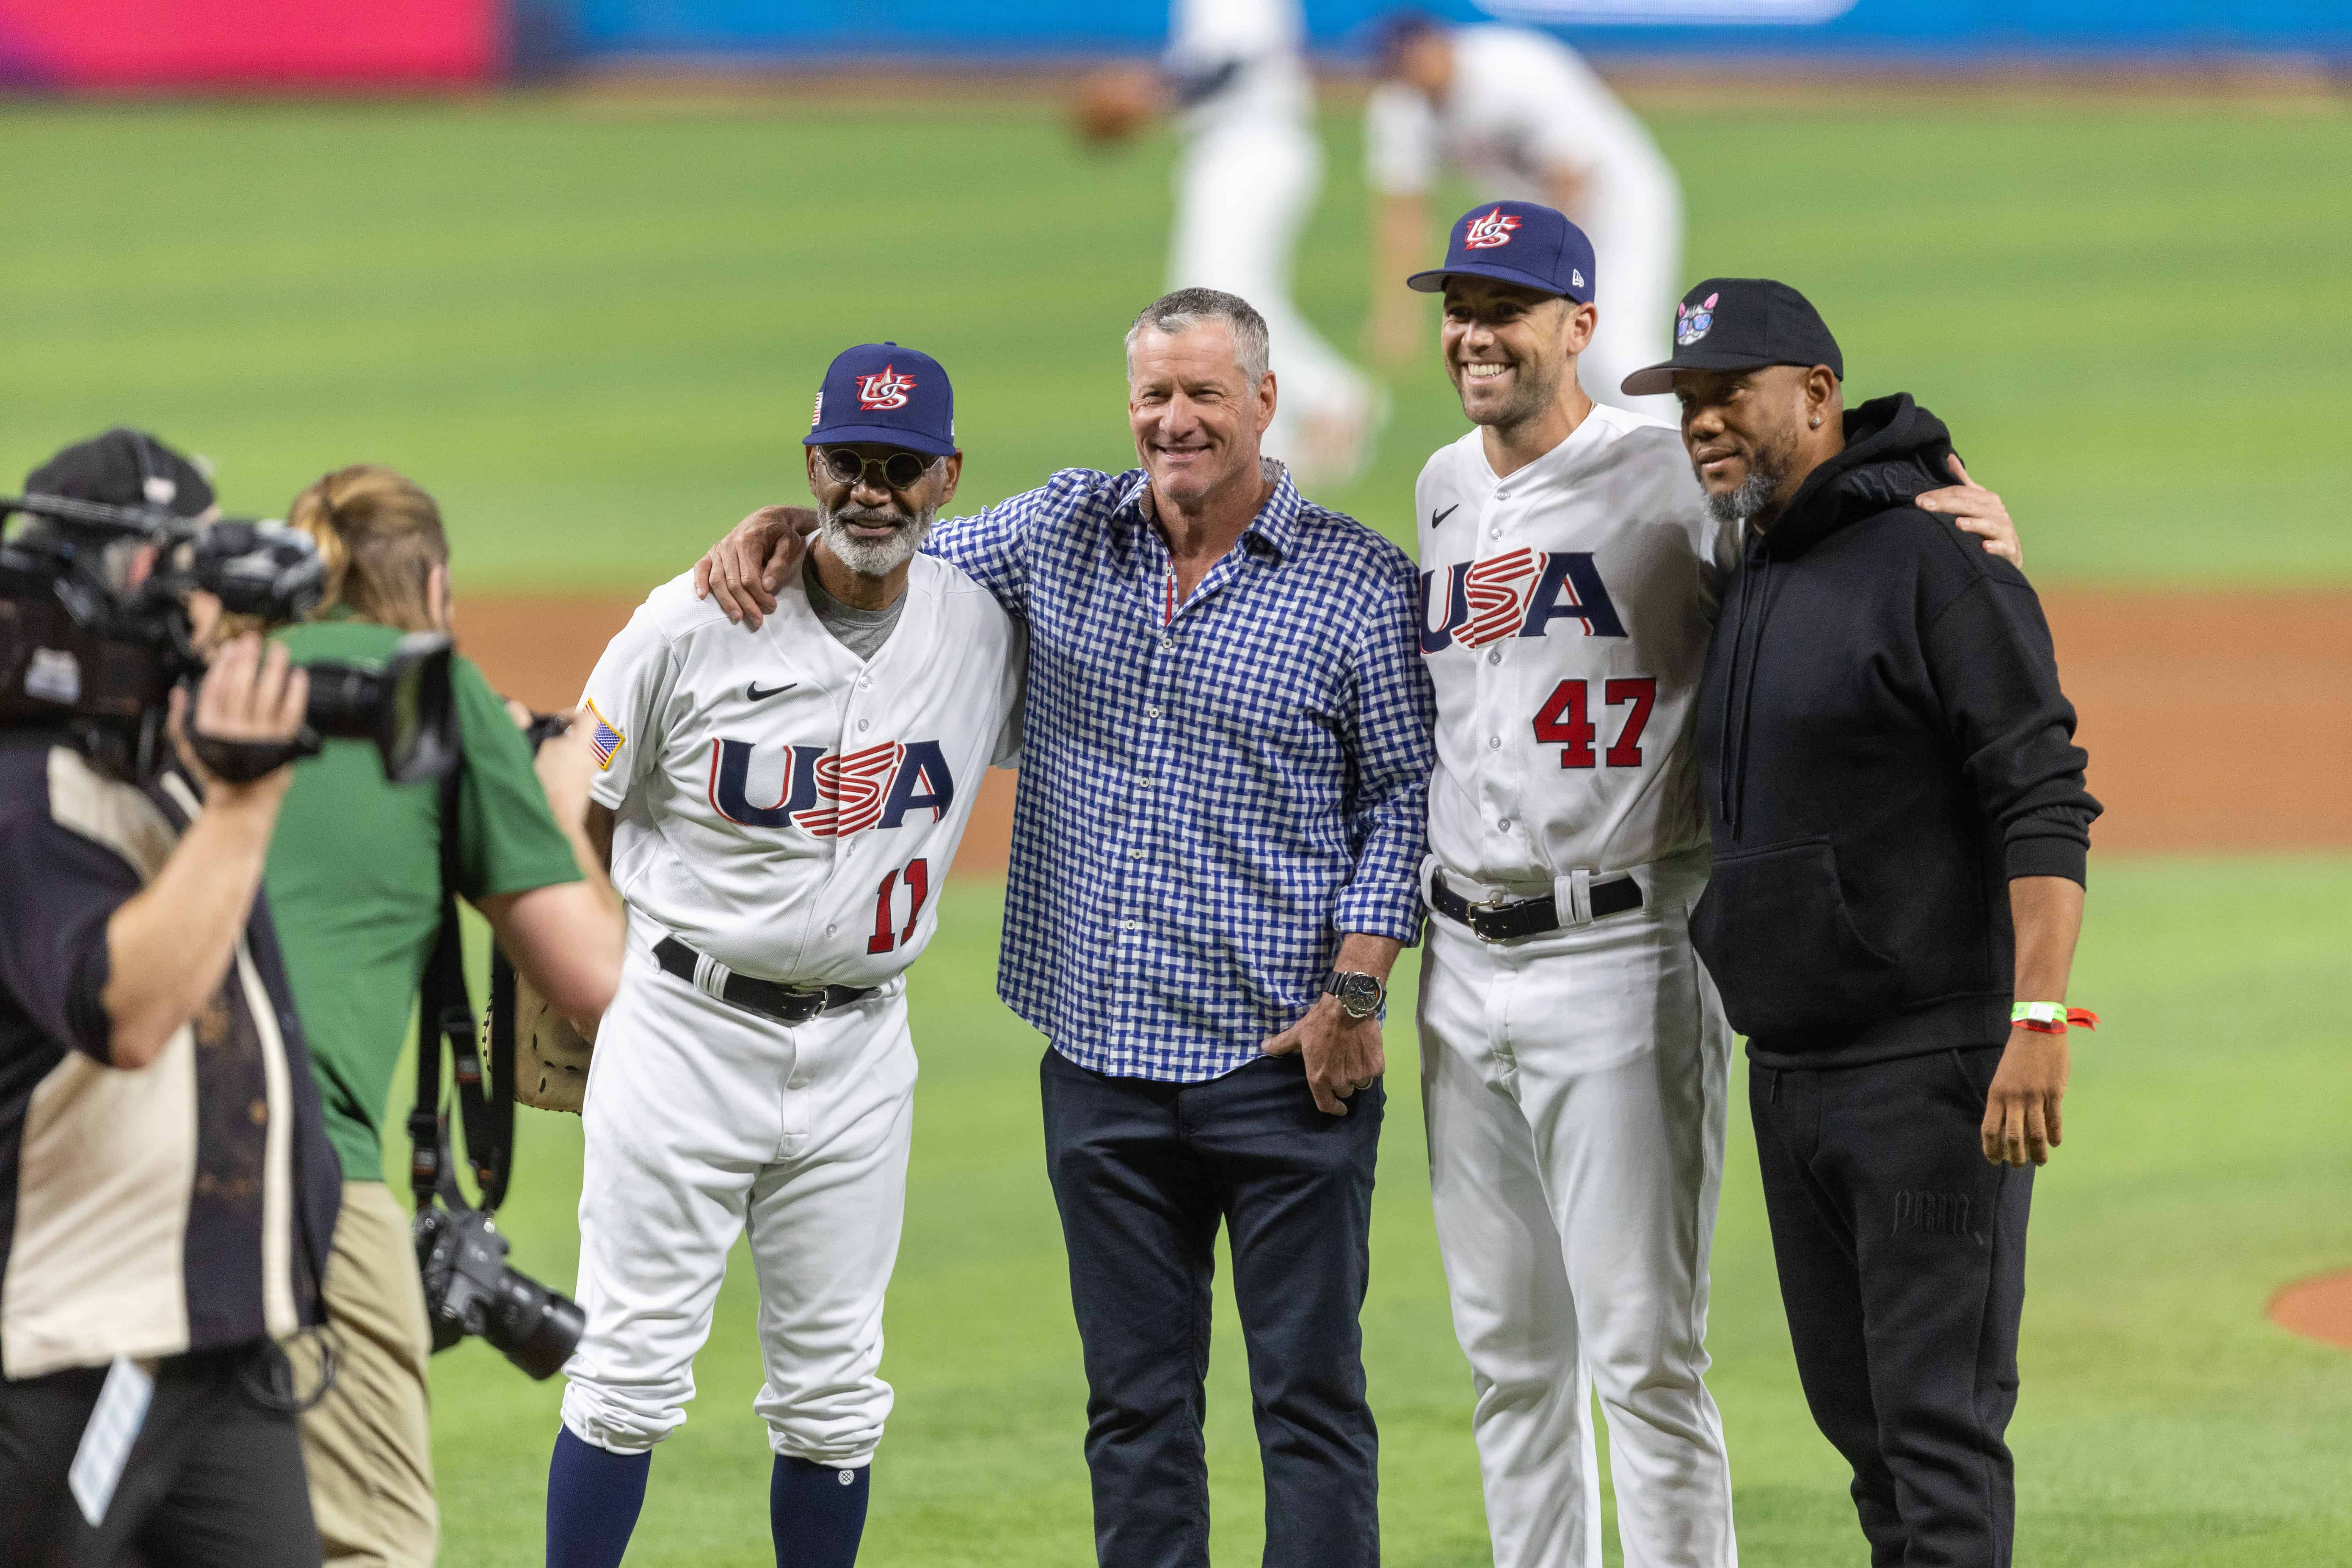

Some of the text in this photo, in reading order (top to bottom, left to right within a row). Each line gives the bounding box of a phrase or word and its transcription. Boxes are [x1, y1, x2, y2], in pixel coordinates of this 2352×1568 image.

[1420, 543, 1628, 654] USA
[1532, 677, 1657, 769] 47
[708, 737, 954, 840] USA
[866, 858, 928, 955] 11
